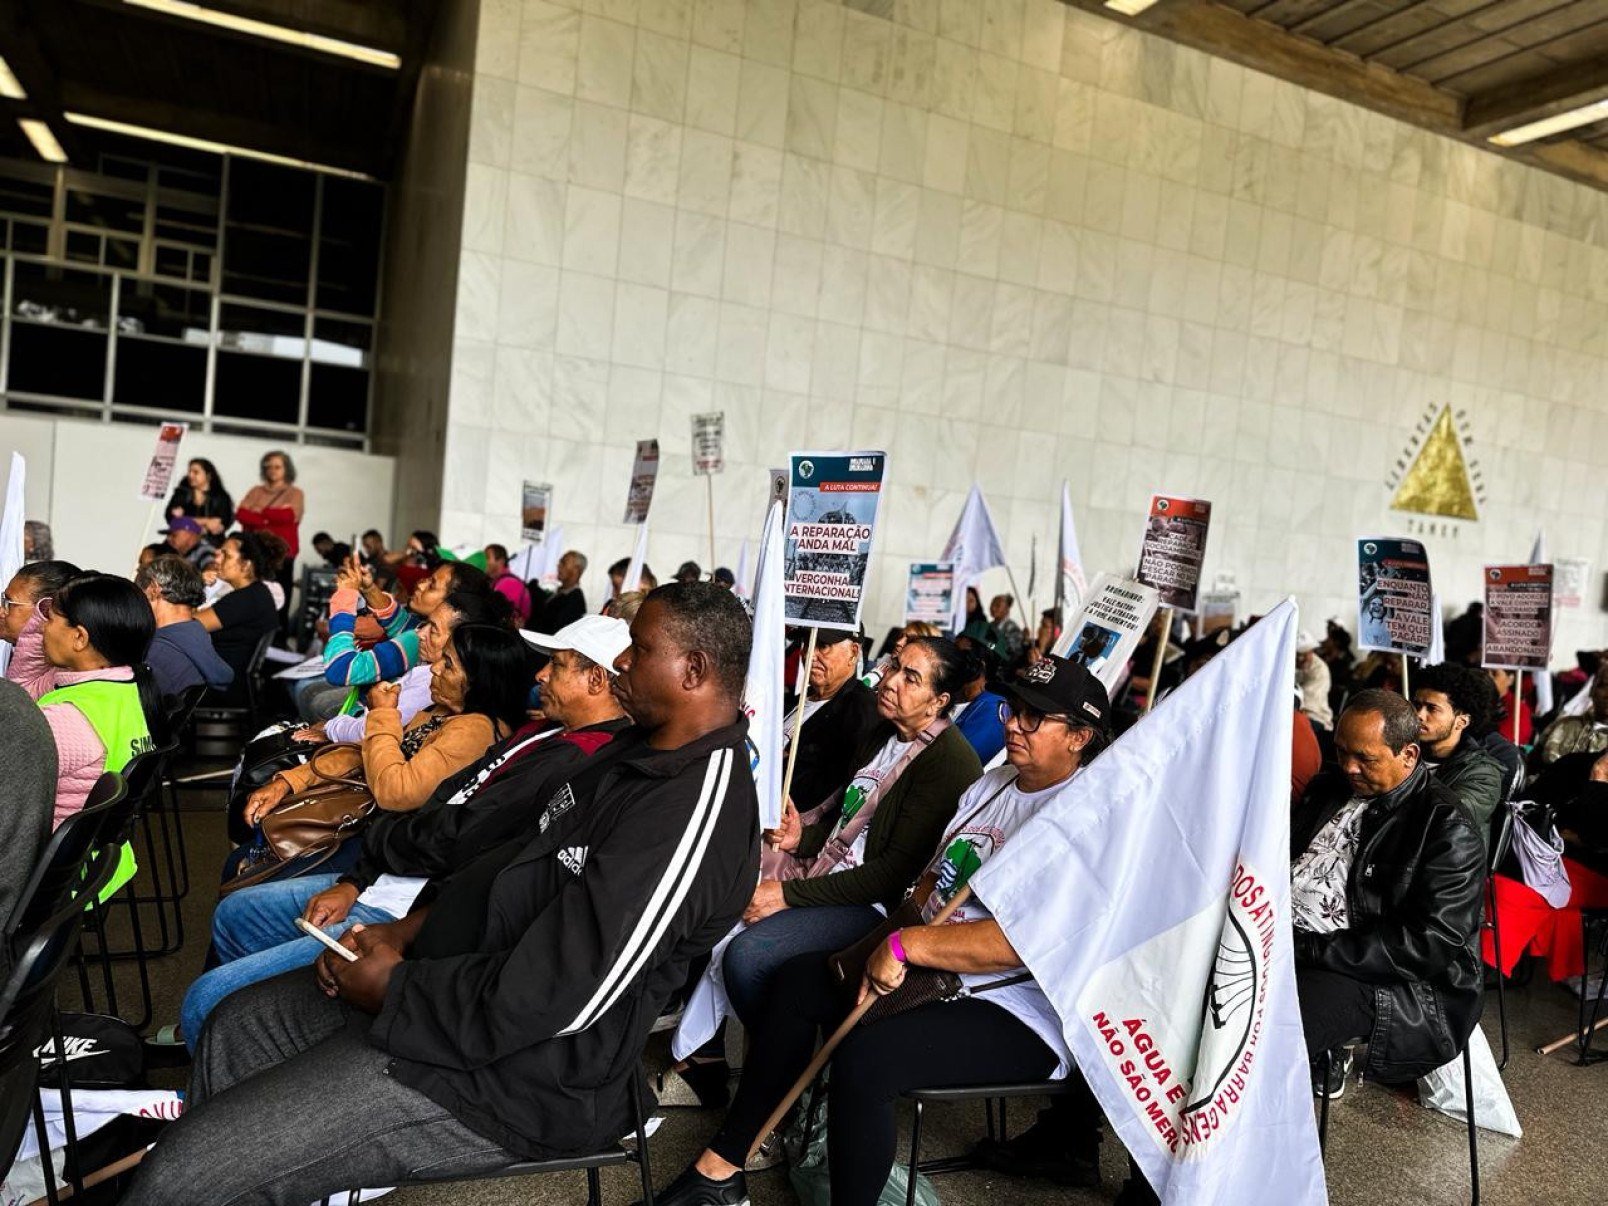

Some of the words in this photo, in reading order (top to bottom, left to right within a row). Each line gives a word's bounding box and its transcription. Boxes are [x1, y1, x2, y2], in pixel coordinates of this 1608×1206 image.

[790, 526, 798, 536] A
[802, 525, 870, 540] REPARAÇÃO
[798, 539, 829, 550] ANDA
[795, 574, 849, 586] VERGONHA
[1377, 580, 1429, 593] ENQUANTO
[784, 584, 860, 599] NTERNACIONAL!
[1404, 614, 1428, 624] VALE
[1387, 621, 1407, 631] TEM
[1407, 624, 1428, 635] QUE
[1093, 1011, 1125, 1056] NÃO
[1120, 1059, 1151, 1102] SÃO
[1122, 1019, 1172, 1086] ÁGUA
[1165, 1084, 1187, 1104] E
